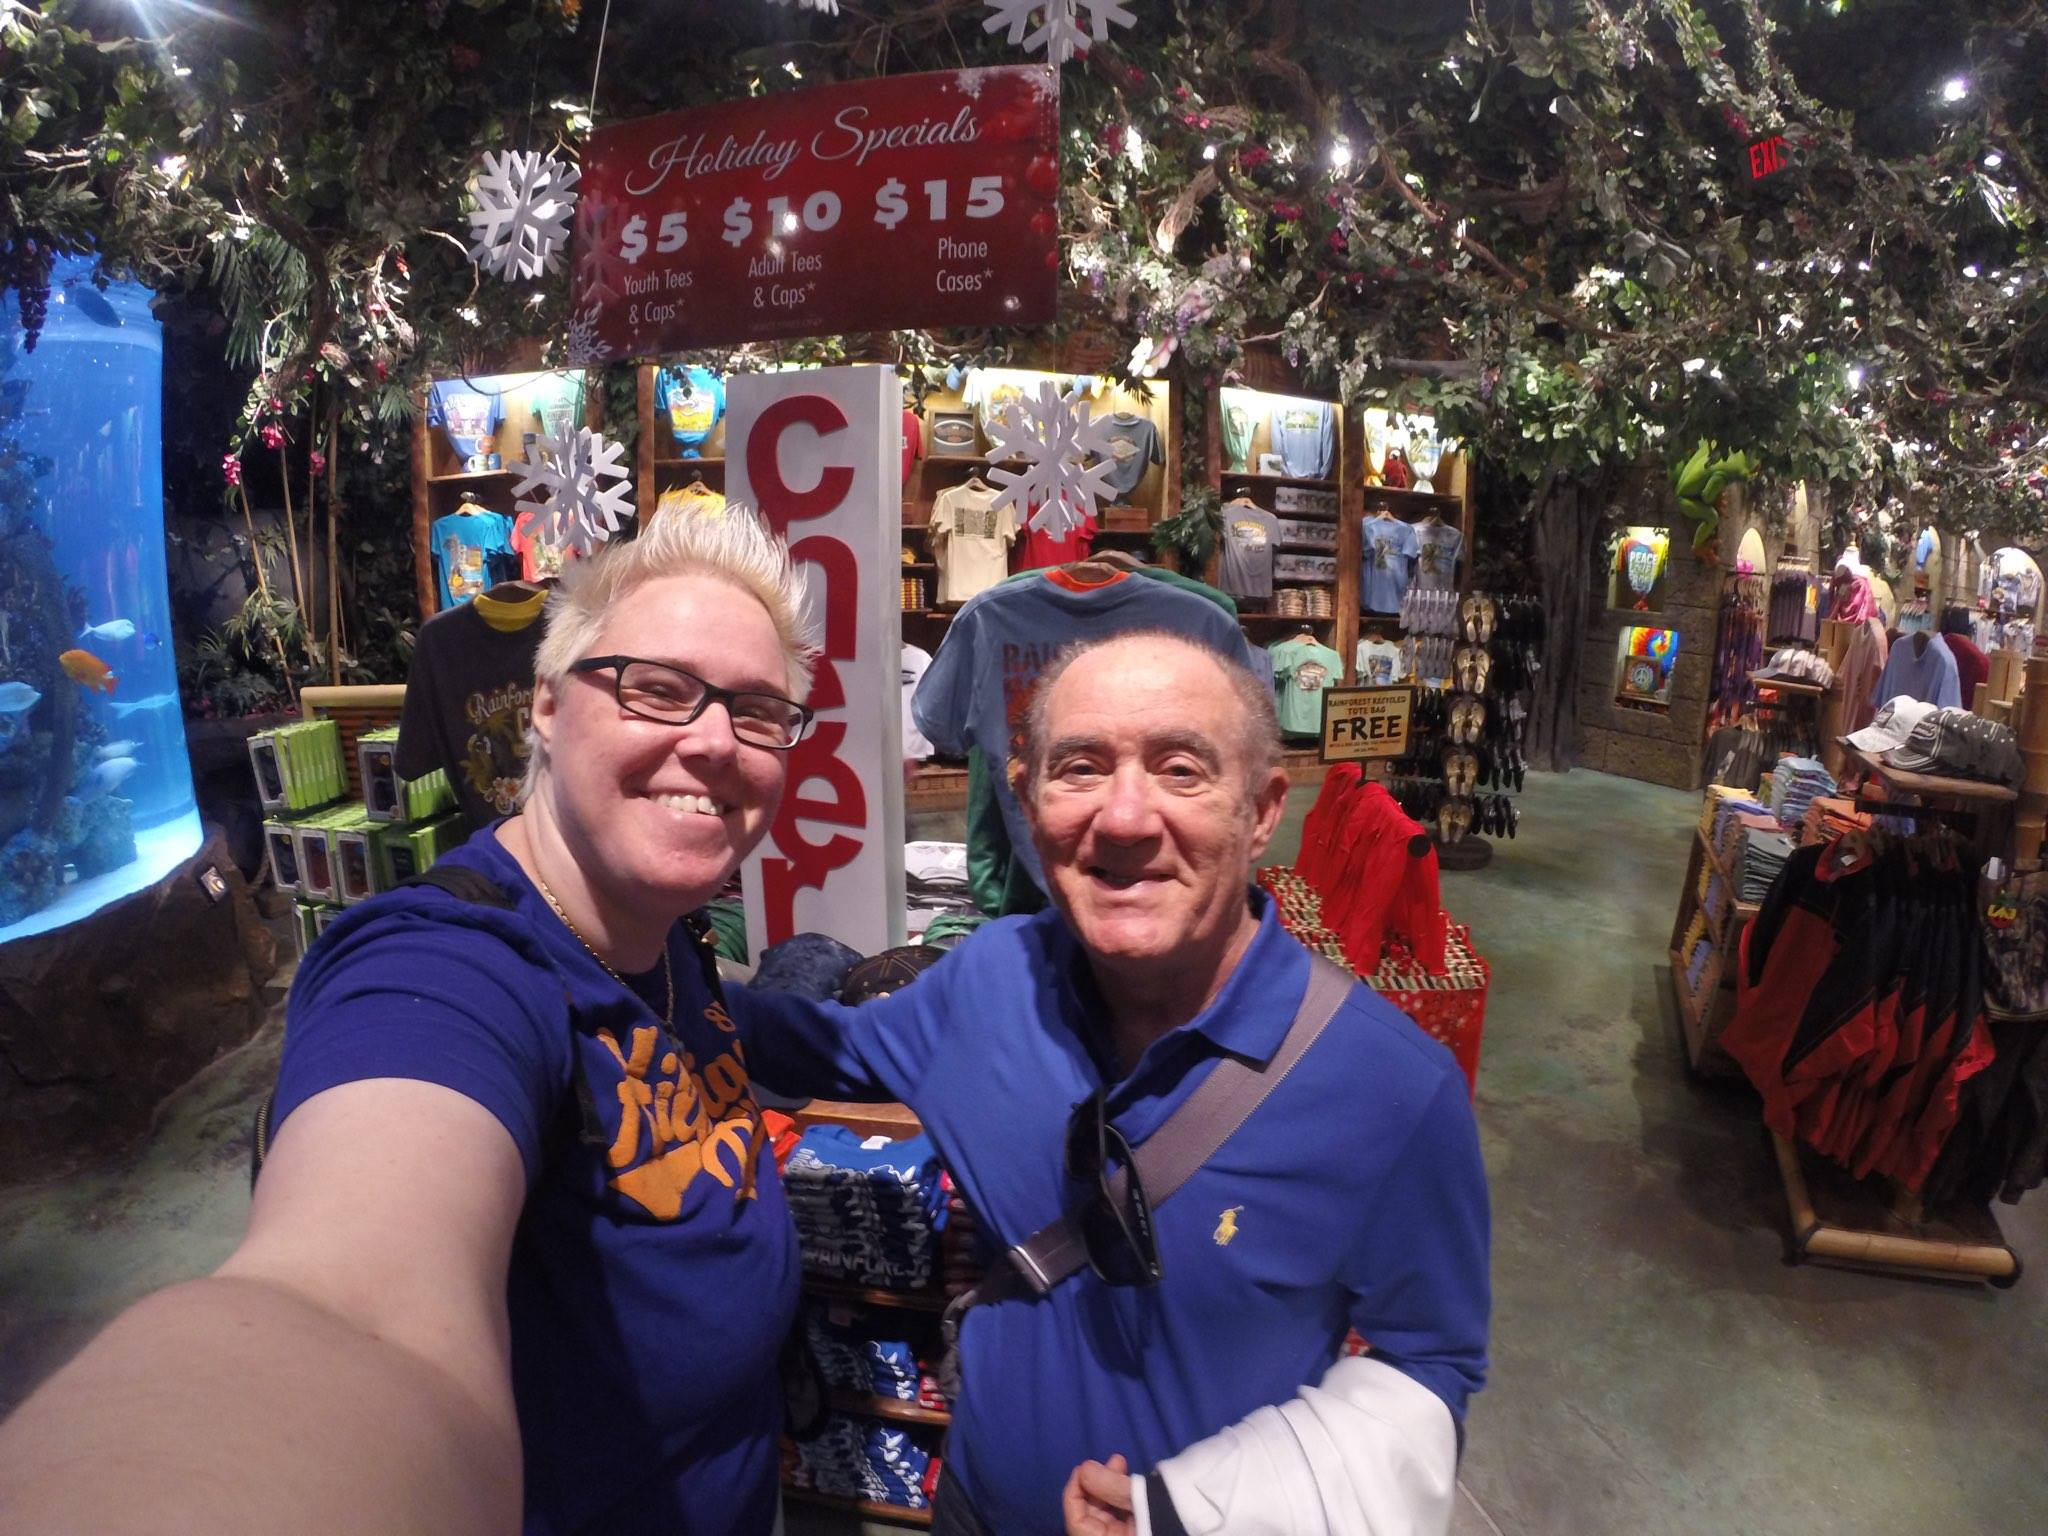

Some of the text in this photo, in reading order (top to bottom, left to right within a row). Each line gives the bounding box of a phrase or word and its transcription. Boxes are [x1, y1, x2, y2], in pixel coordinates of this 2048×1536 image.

[625, 105, 981, 195] Holiday Specials
[873, 176, 1005, 230] $15
[721, 190, 842, 248] $10
[619, 211, 688, 264] $5
[938, 236, 988, 260] Phone
[748, 252, 822, 277] Adult Tees
[624, 270, 693, 296] Youth Tees
[752, 286, 765, 308] &
[628, 304, 639, 325] &
[1629, 551, 1659, 566] PEACE
[1347, 706, 1386, 715] TOTE BAG
[1332, 715, 1402, 742] FREE
